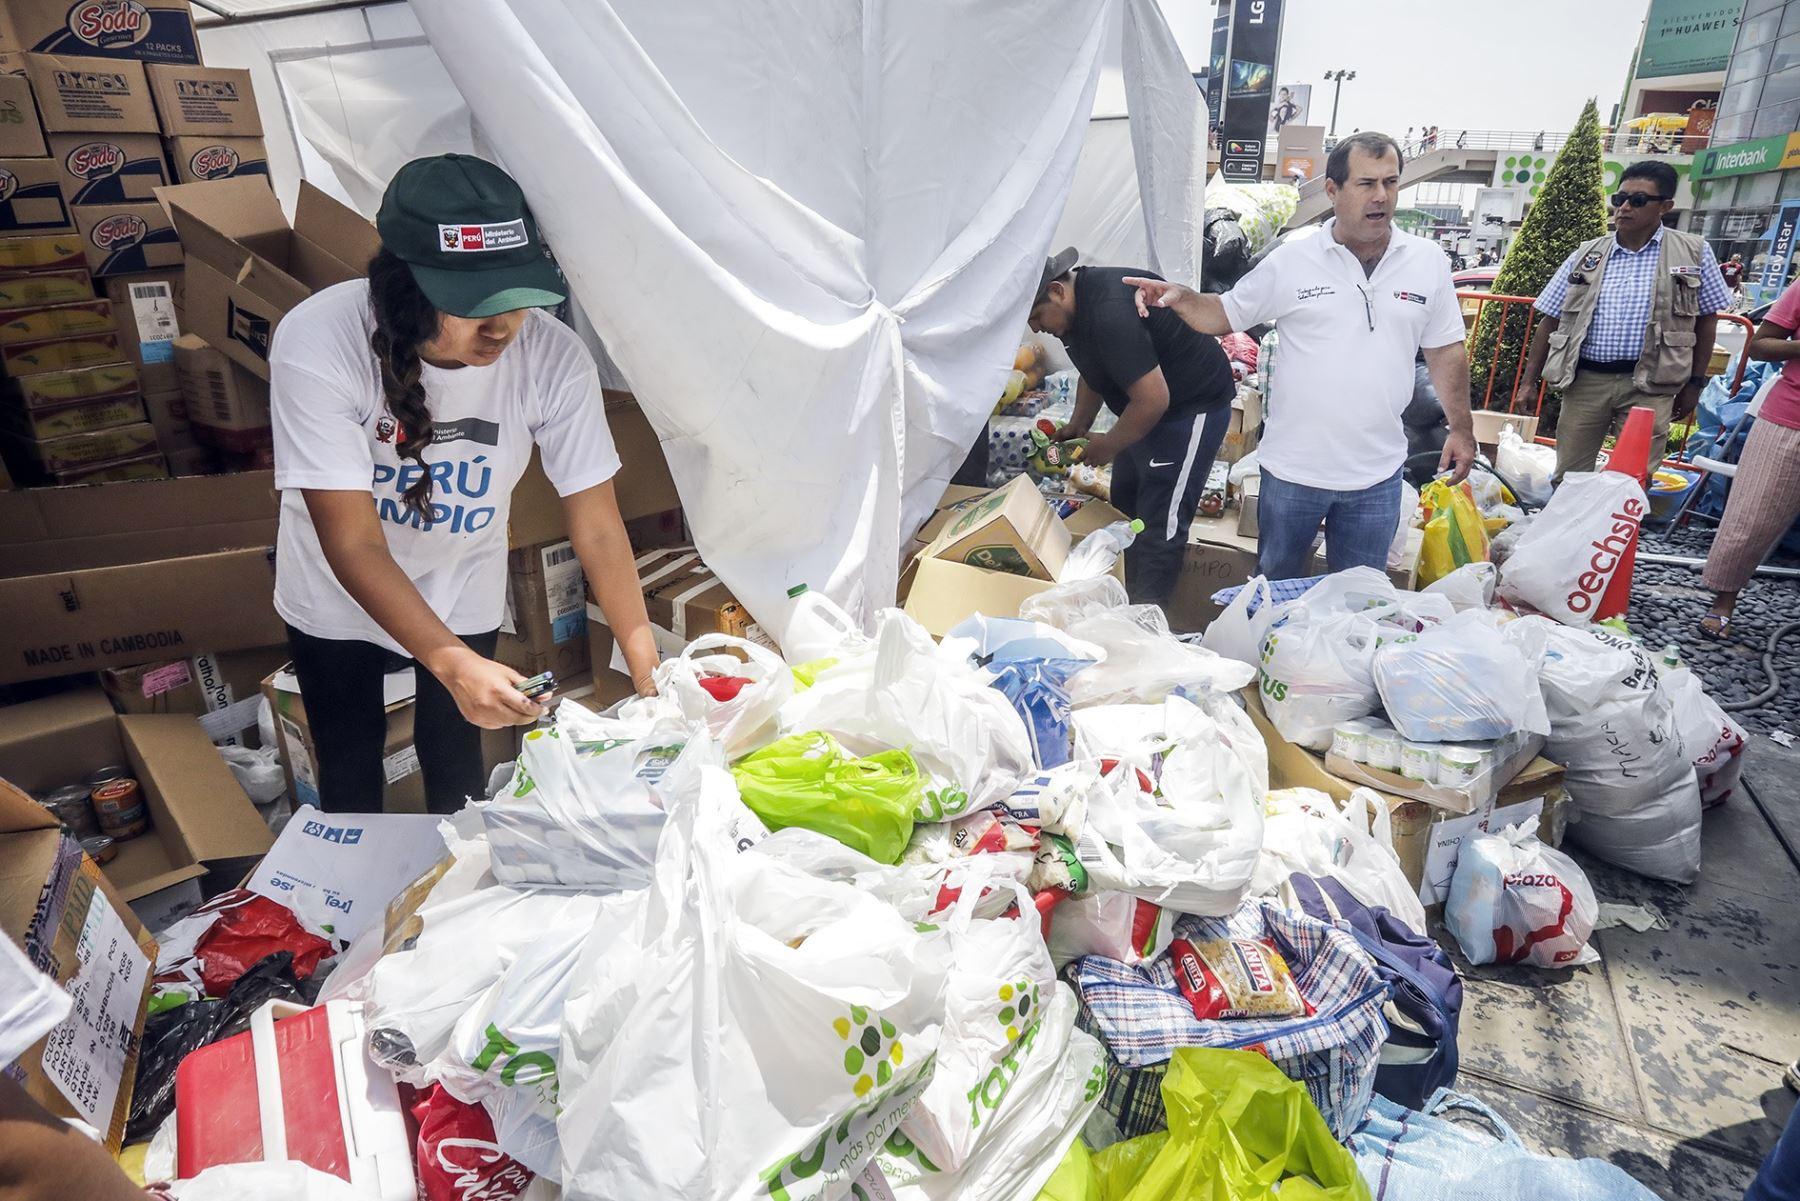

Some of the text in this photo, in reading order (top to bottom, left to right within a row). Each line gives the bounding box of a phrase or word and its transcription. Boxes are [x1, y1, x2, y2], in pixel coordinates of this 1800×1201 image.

[81, 2, 139, 38] Soda
[1250, 1, 1264, 24] LG
[1675, 20, 1725, 35] HUAWEI
[156, 43, 182, 52] PACKS
[75, 146, 117, 173] Soda
[198, 149, 231, 173] Soda
[1716, 146, 1768, 170] Interbank
[98, 217, 139, 244] Soda
[463, 229, 514, 242] PERÚ Ministerio
[1767, 222, 1793, 287] movistar
[433, 427, 458, 435] nisterio
[436, 431, 465, 441] Ambiente
[373, 455, 492, 498] PERÚ
[374, 498, 495, 534] MPIO
[1566, 497, 1643, 614] oechsle
[23, 630, 184, 667] MADE IN CAMBODIA
[108, 937, 118, 961] PCS
[118, 951, 128, 975] KGS
[123, 958, 134, 983] KGS
[1184, 956, 1204, 987] ANITA
[1238, 942, 1272, 992] ANITA
[76, 972, 116, 1100] MADE IN CAMBODIA
[839, 1140, 864, 1172] más
[866, 1121, 887, 1151] por
